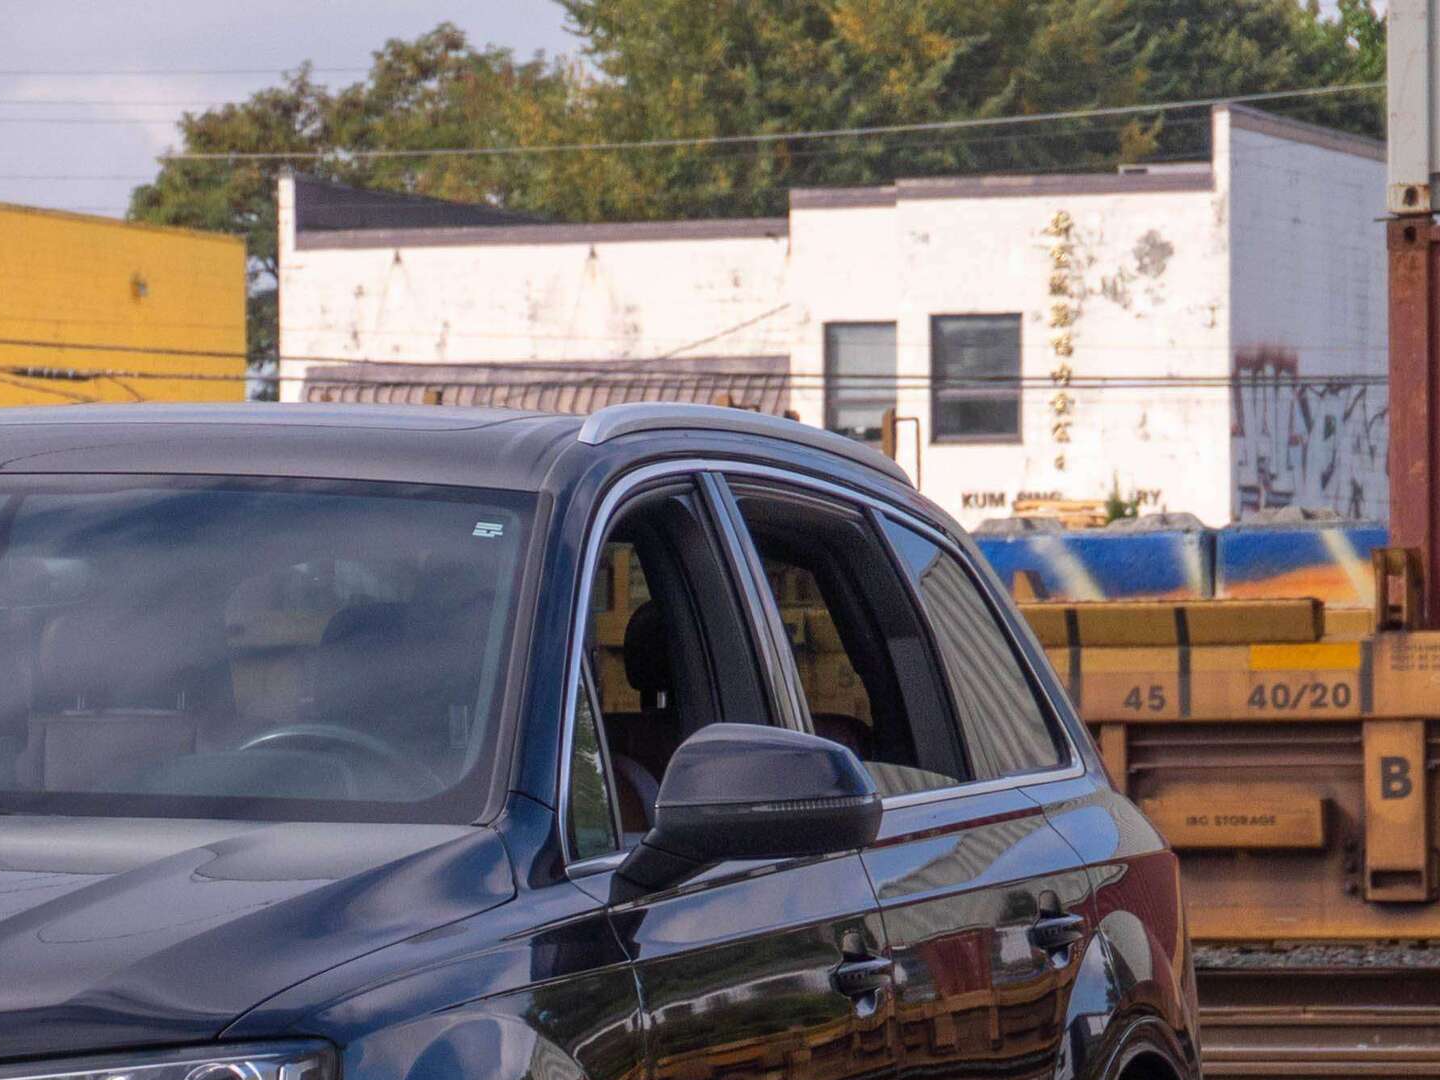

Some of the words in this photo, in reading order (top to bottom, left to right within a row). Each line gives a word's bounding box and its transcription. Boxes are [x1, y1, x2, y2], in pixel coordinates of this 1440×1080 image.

[961, 492, 1006, 508] KUM
[1124, 685, 1166, 711] 45
[1247, 682, 1351, 710] 40/20
[1380, 756, 1412, 799] B
[1215, 815, 1277, 827] STORAGE
